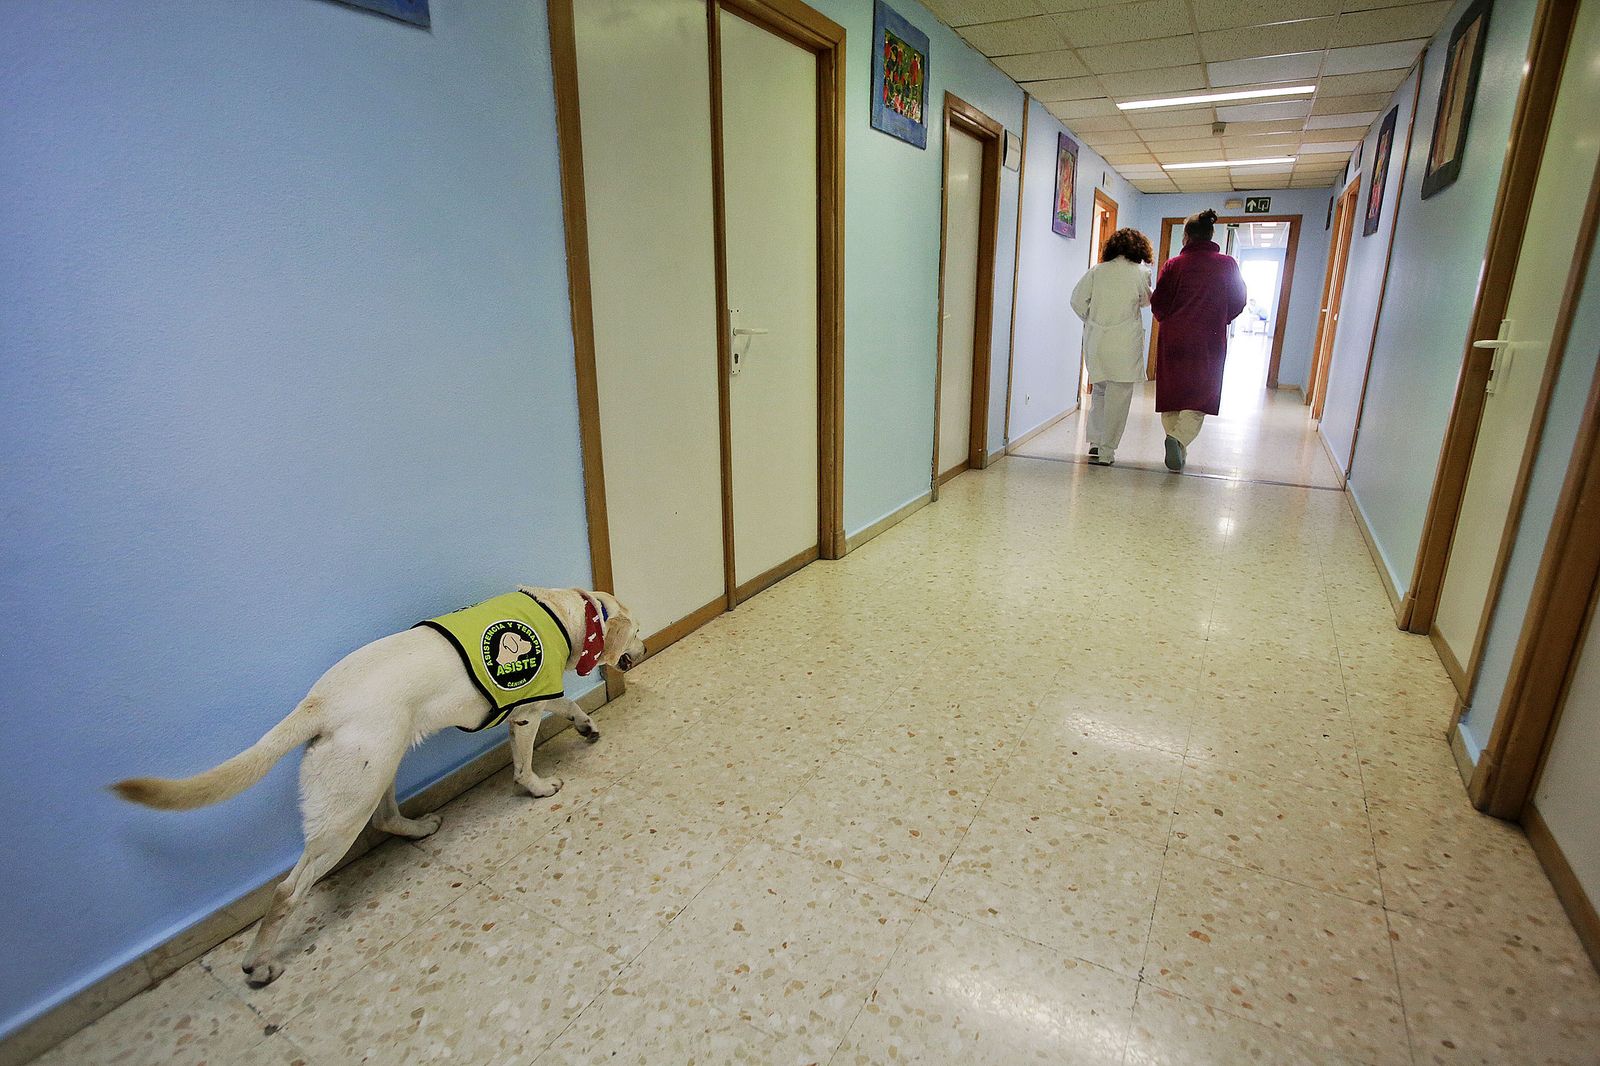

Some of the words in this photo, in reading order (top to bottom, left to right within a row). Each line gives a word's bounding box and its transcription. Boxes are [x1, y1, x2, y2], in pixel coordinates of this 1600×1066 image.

[483, 623, 506, 667] ASISTENCIA
[516, 623, 542, 655] TERAPIA
[496, 657, 537, 676] ASISTE
